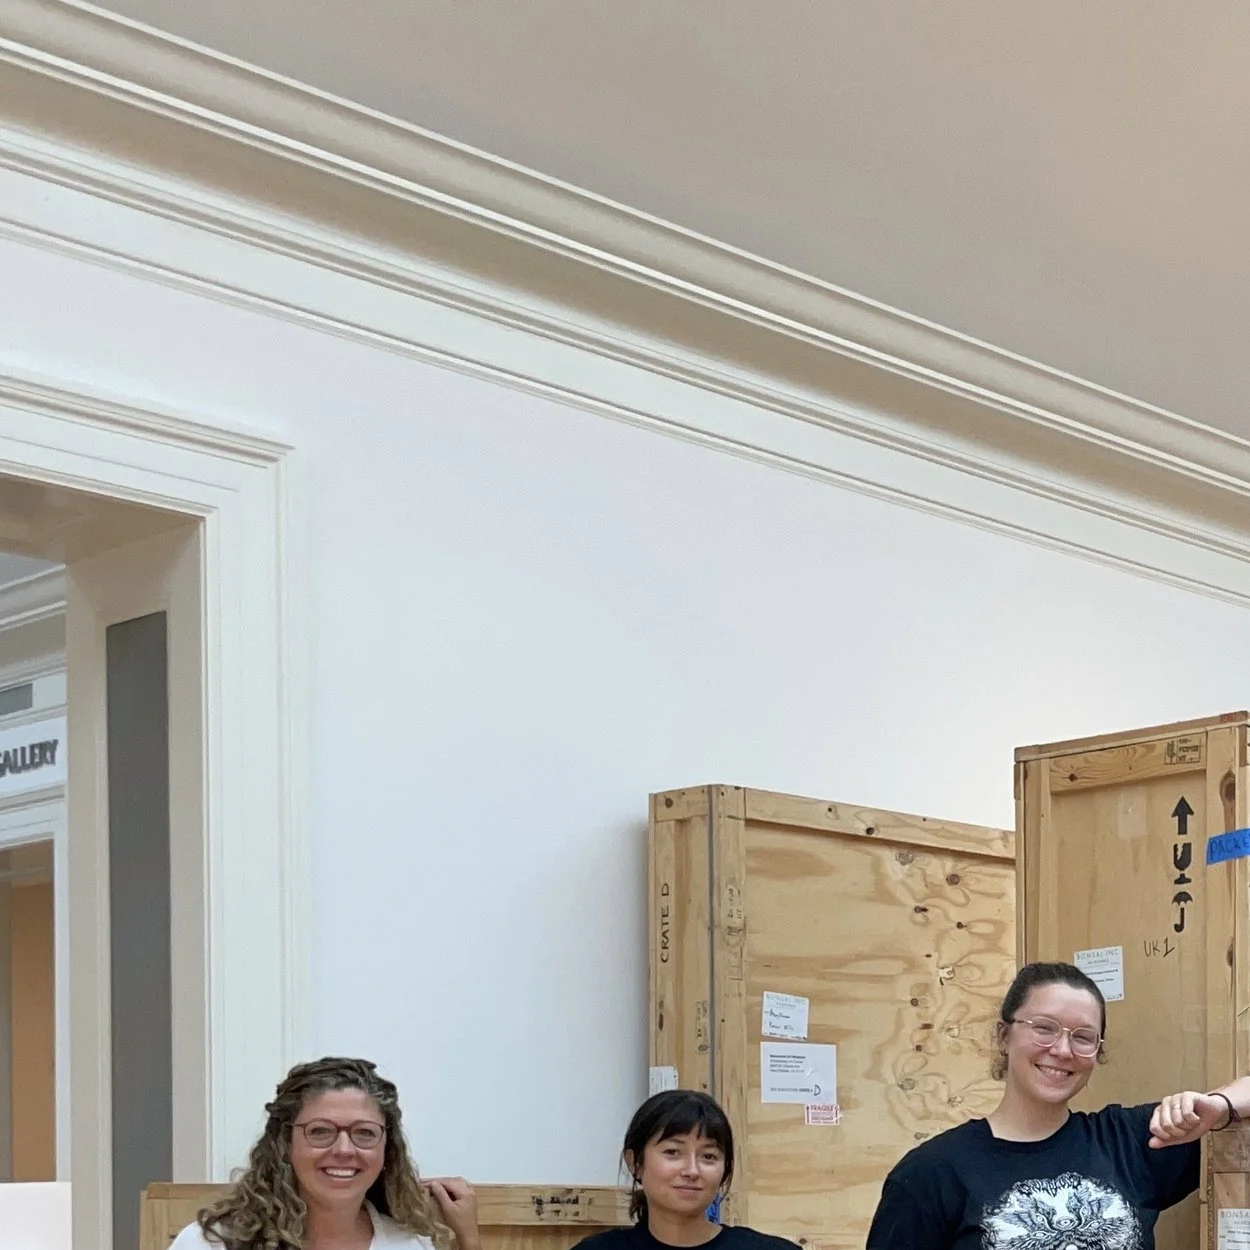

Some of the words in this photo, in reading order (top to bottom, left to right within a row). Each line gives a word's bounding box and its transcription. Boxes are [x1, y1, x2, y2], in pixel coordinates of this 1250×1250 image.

[0, 739, 59, 778] ALLERY
[661, 883, 670, 896] D
[661, 905, 670, 964] CRATE
